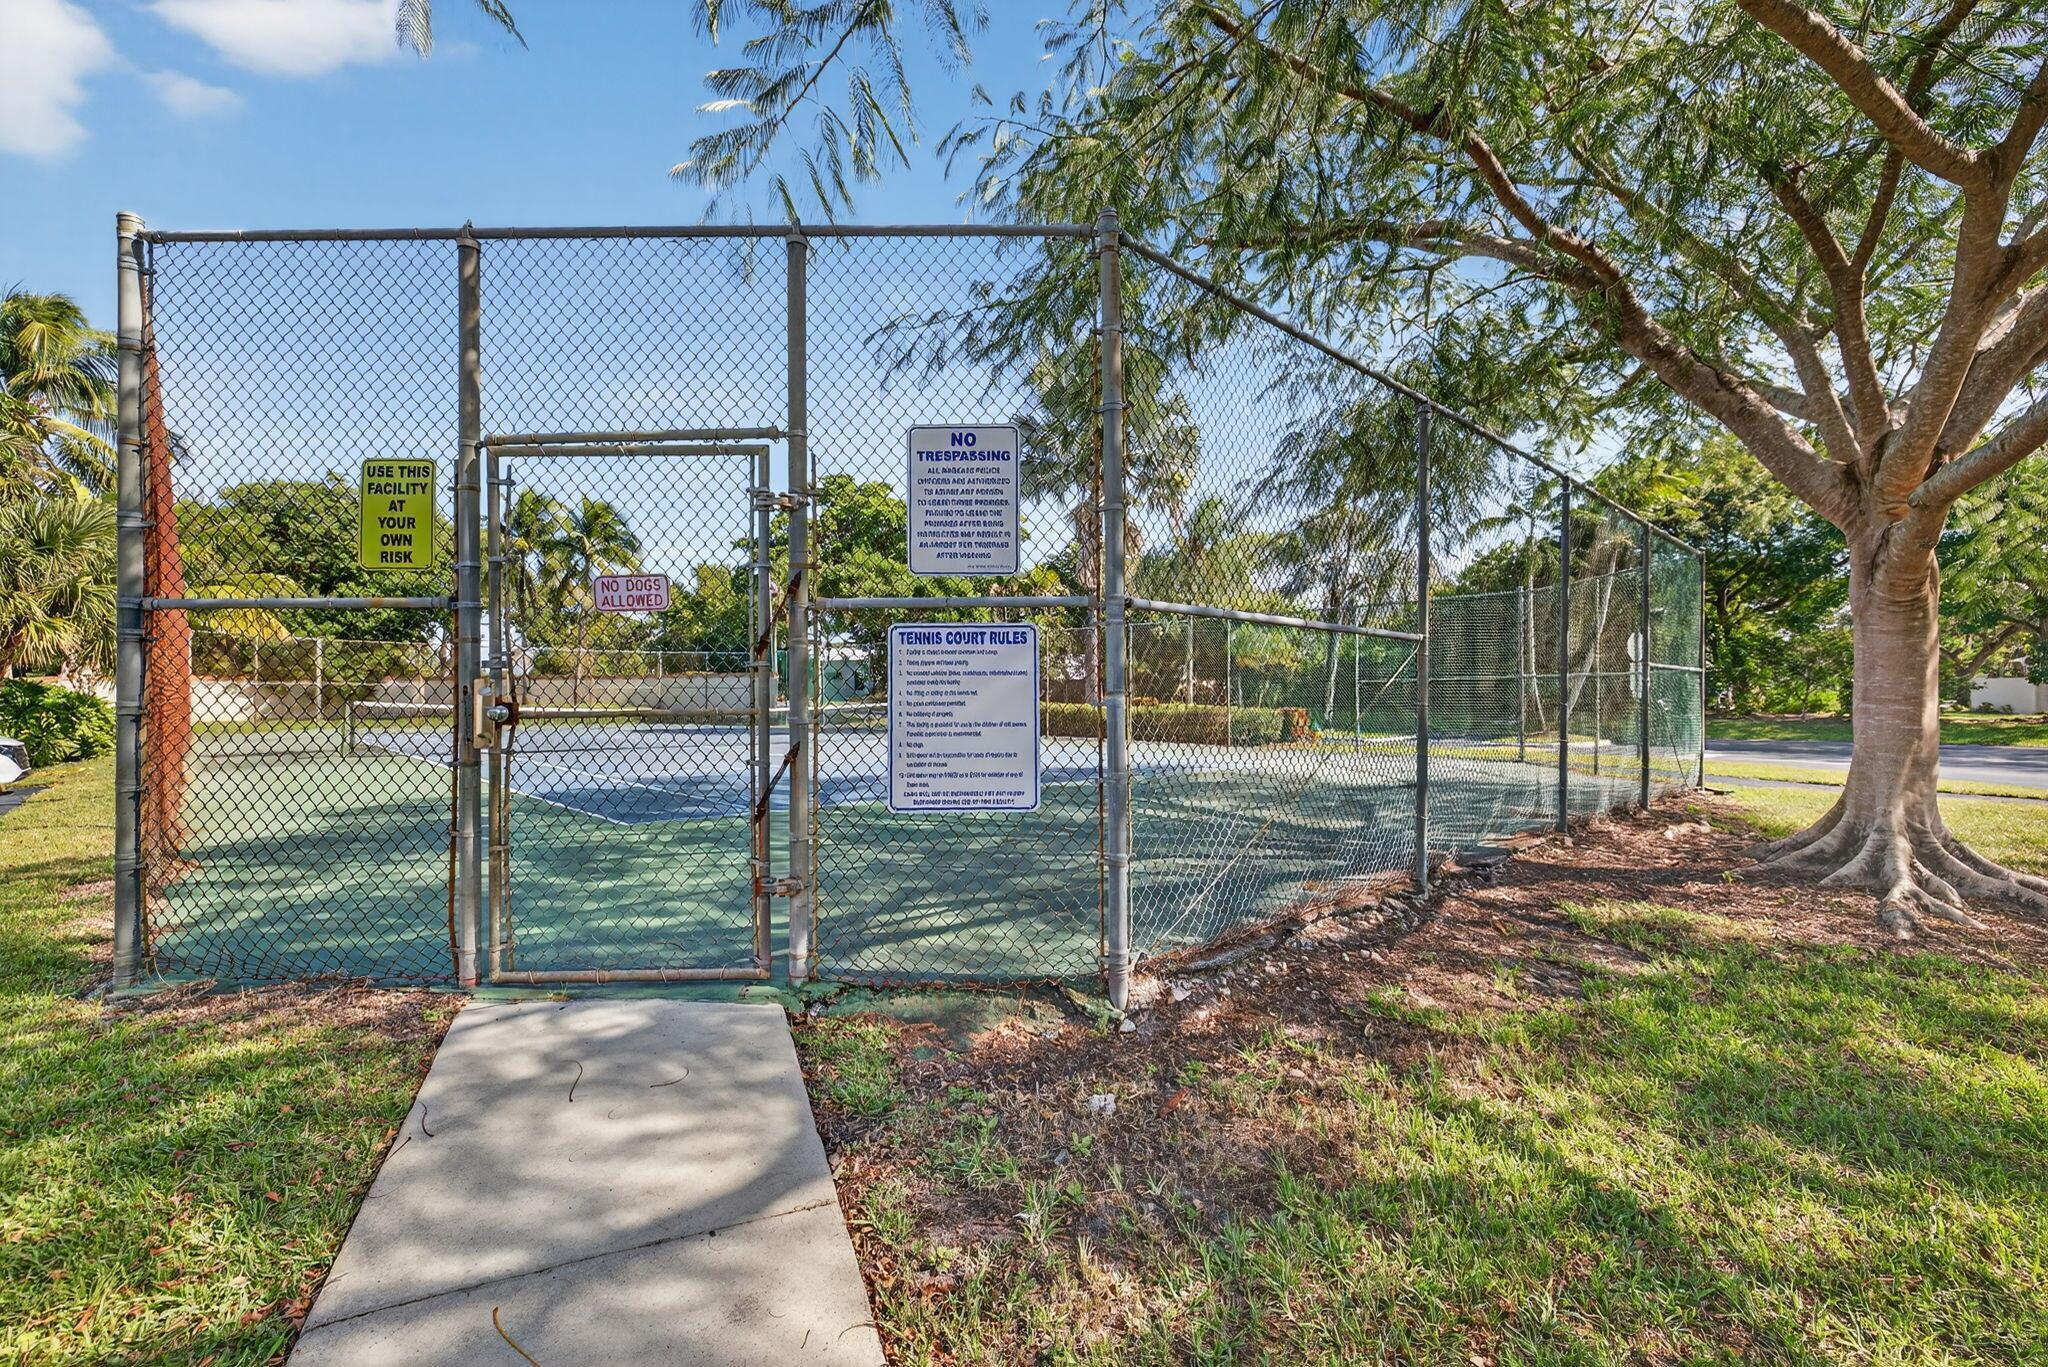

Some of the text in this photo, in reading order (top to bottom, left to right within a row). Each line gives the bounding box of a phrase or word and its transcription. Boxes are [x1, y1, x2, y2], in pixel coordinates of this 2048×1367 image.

[951, 432, 976, 447] NO
[916, 450, 1011, 462] TRESPASSING
[367, 466, 430, 478] USE THIS
[367, 482, 428, 495] FACILITY
[388, 500, 406, 512] AT
[378, 517, 416, 529] YOUR
[380, 534, 412, 546] OWN
[380, 551, 413, 563] RISK
[601, 578, 661, 593] NO DOGS
[601, 594, 663, 607] ALLOWED
[899, 631, 1028, 645] TENNIS COURT RULES
